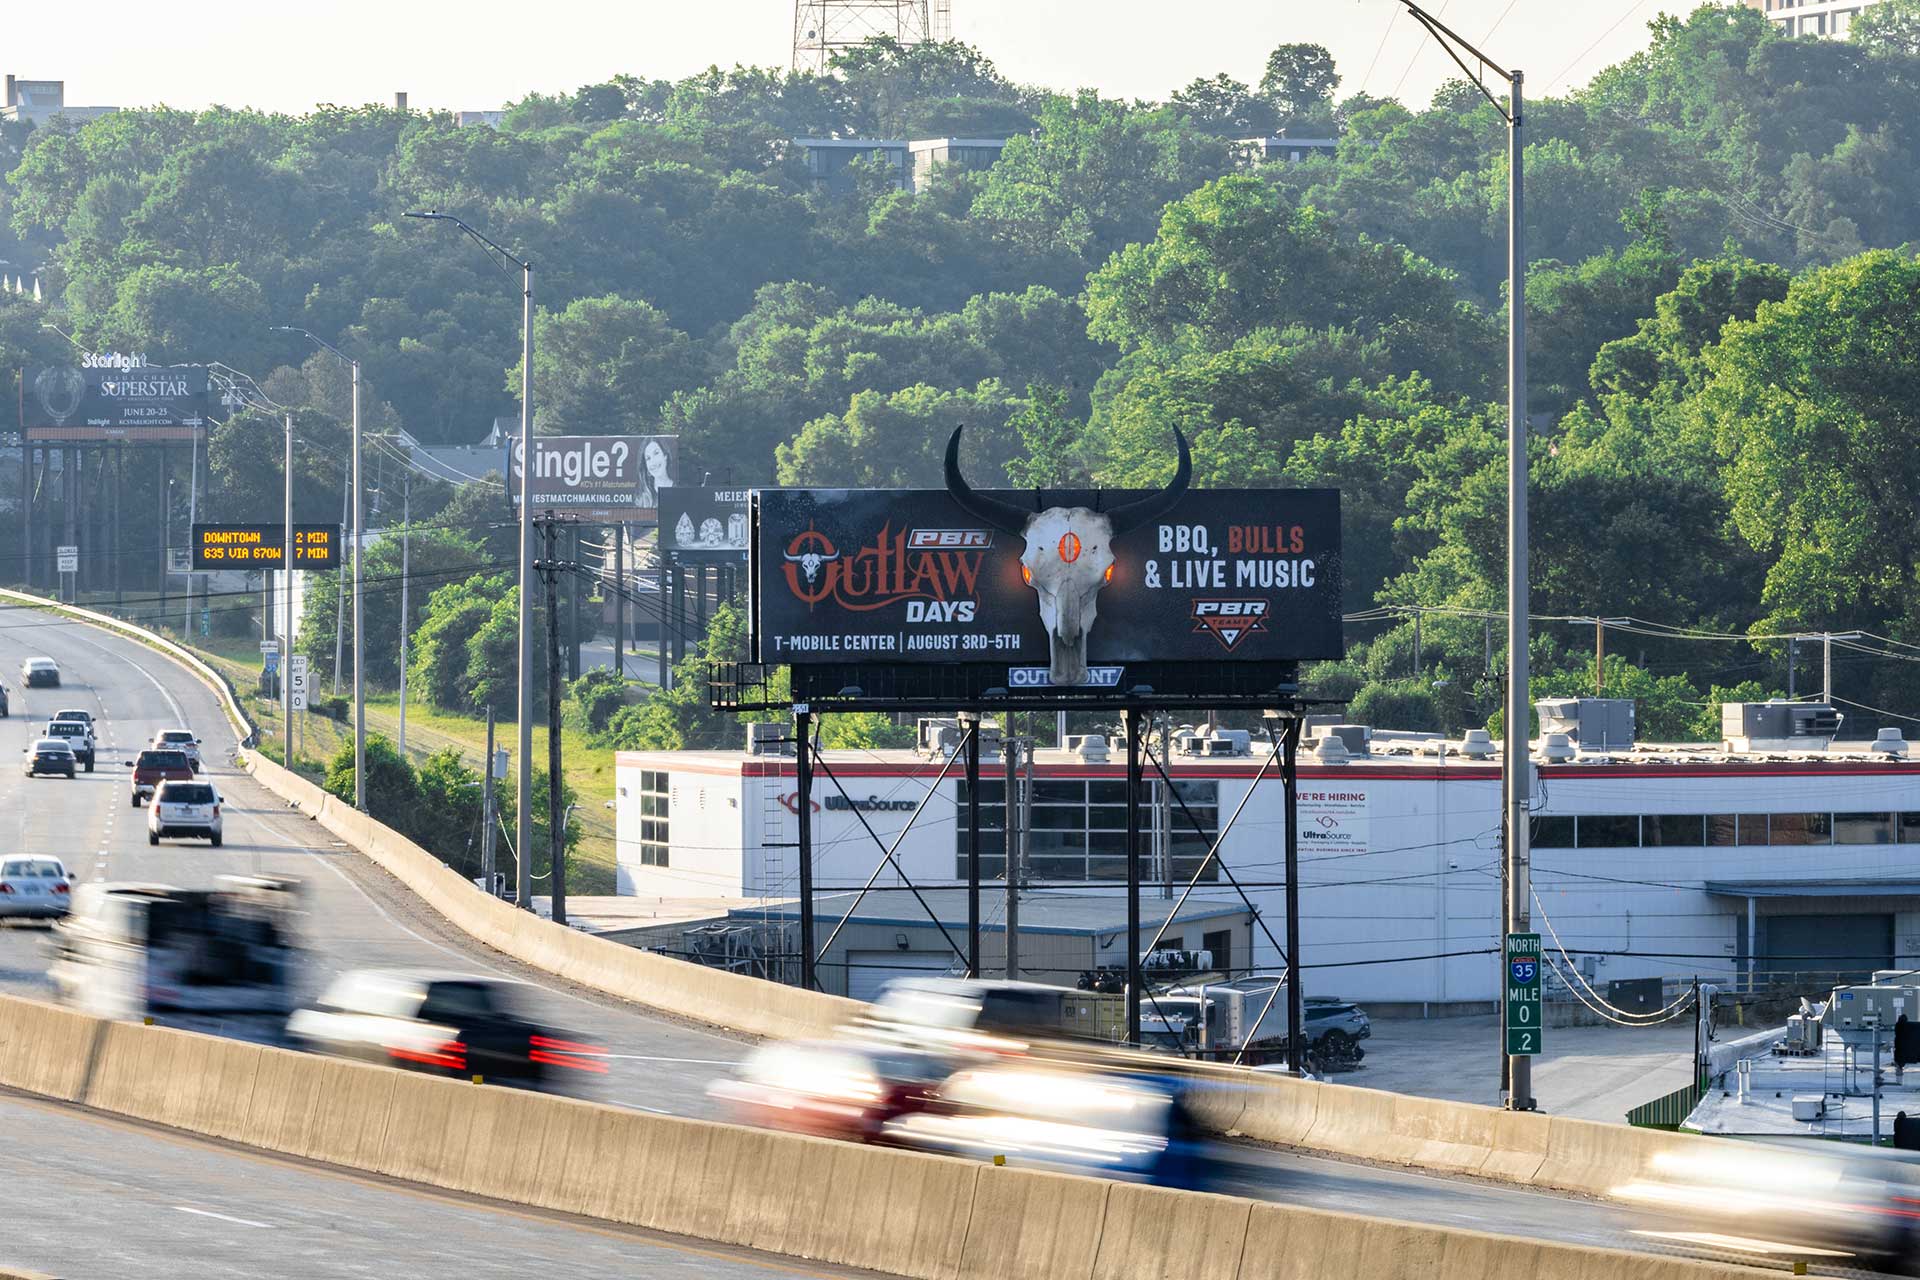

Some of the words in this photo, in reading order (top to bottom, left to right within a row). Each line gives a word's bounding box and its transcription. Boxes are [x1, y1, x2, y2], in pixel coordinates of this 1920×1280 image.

[81, 351, 147, 373] Starlight
[101, 381, 190, 397] SUPERSTAR
[124, 408, 145, 416] JUNE
[203, 532, 261, 543] DOWNTOWN
[295, 532, 303, 543] 2
[307, 532, 328, 543] MIN
[914, 531, 986, 545] PBR
[1158, 525, 1219, 556] BBQ,
[1228, 525, 1304, 553] BULLS
[203, 547, 224, 559] 635
[228, 547, 249, 559] VIA
[253, 547, 281, 559] 670W
[295, 547, 303, 559] 7
[307, 547, 328, 559] MIN
[1144, 560, 1162, 588] &
[1171, 560, 1226, 588] LIVE
[1236, 559, 1315, 588] MUSIC
[906, 601, 976, 623] DAYS
[1195, 602, 1266, 615] PBR
[774, 635, 840, 650] T-MOBILE
[844, 635, 895, 650] CENTER
[907, 635, 958, 650] AUGUST
[962, 634, 1021, 649] 3RD-5TH
[1013, 669, 1117, 684] OUTNT
[824, 795, 917, 811] UltraSource
[1328, 792, 1366, 801] HIRING
[1302, 830, 1352, 840] UltraSource
[1508, 938, 1540, 952] NORTH
[1515, 964, 1533, 977] 35
[1509, 987, 1539, 1001] MILE
[1519, 1005, 1530, 1023] 0
